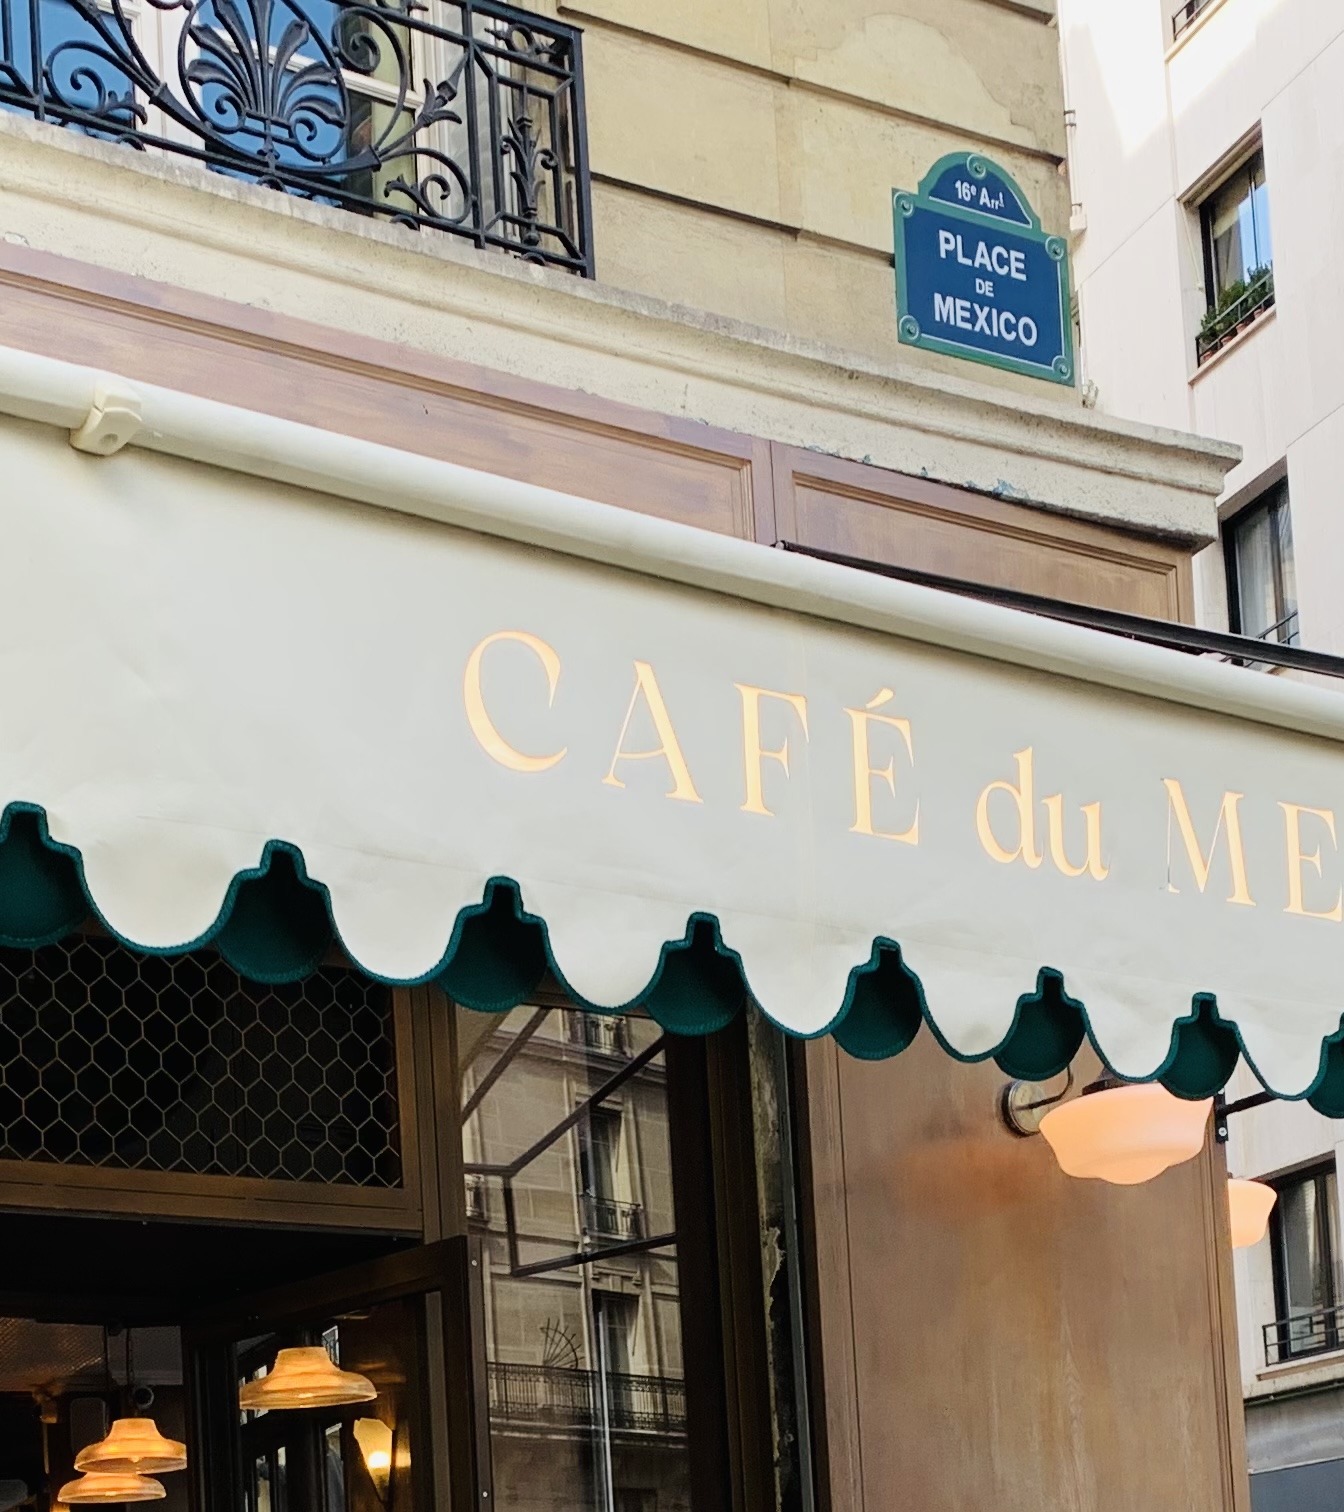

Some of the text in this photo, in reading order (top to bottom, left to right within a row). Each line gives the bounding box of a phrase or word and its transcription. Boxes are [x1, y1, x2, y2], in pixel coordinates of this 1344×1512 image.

[938, 229, 1027, 281] PLACE
[975, 278, 994, 297] DE
[934, 292, 1038, 346] MEXICO
[463, 629, 921, 847] CAFÉ
[976, 745, 1110, 881] du
